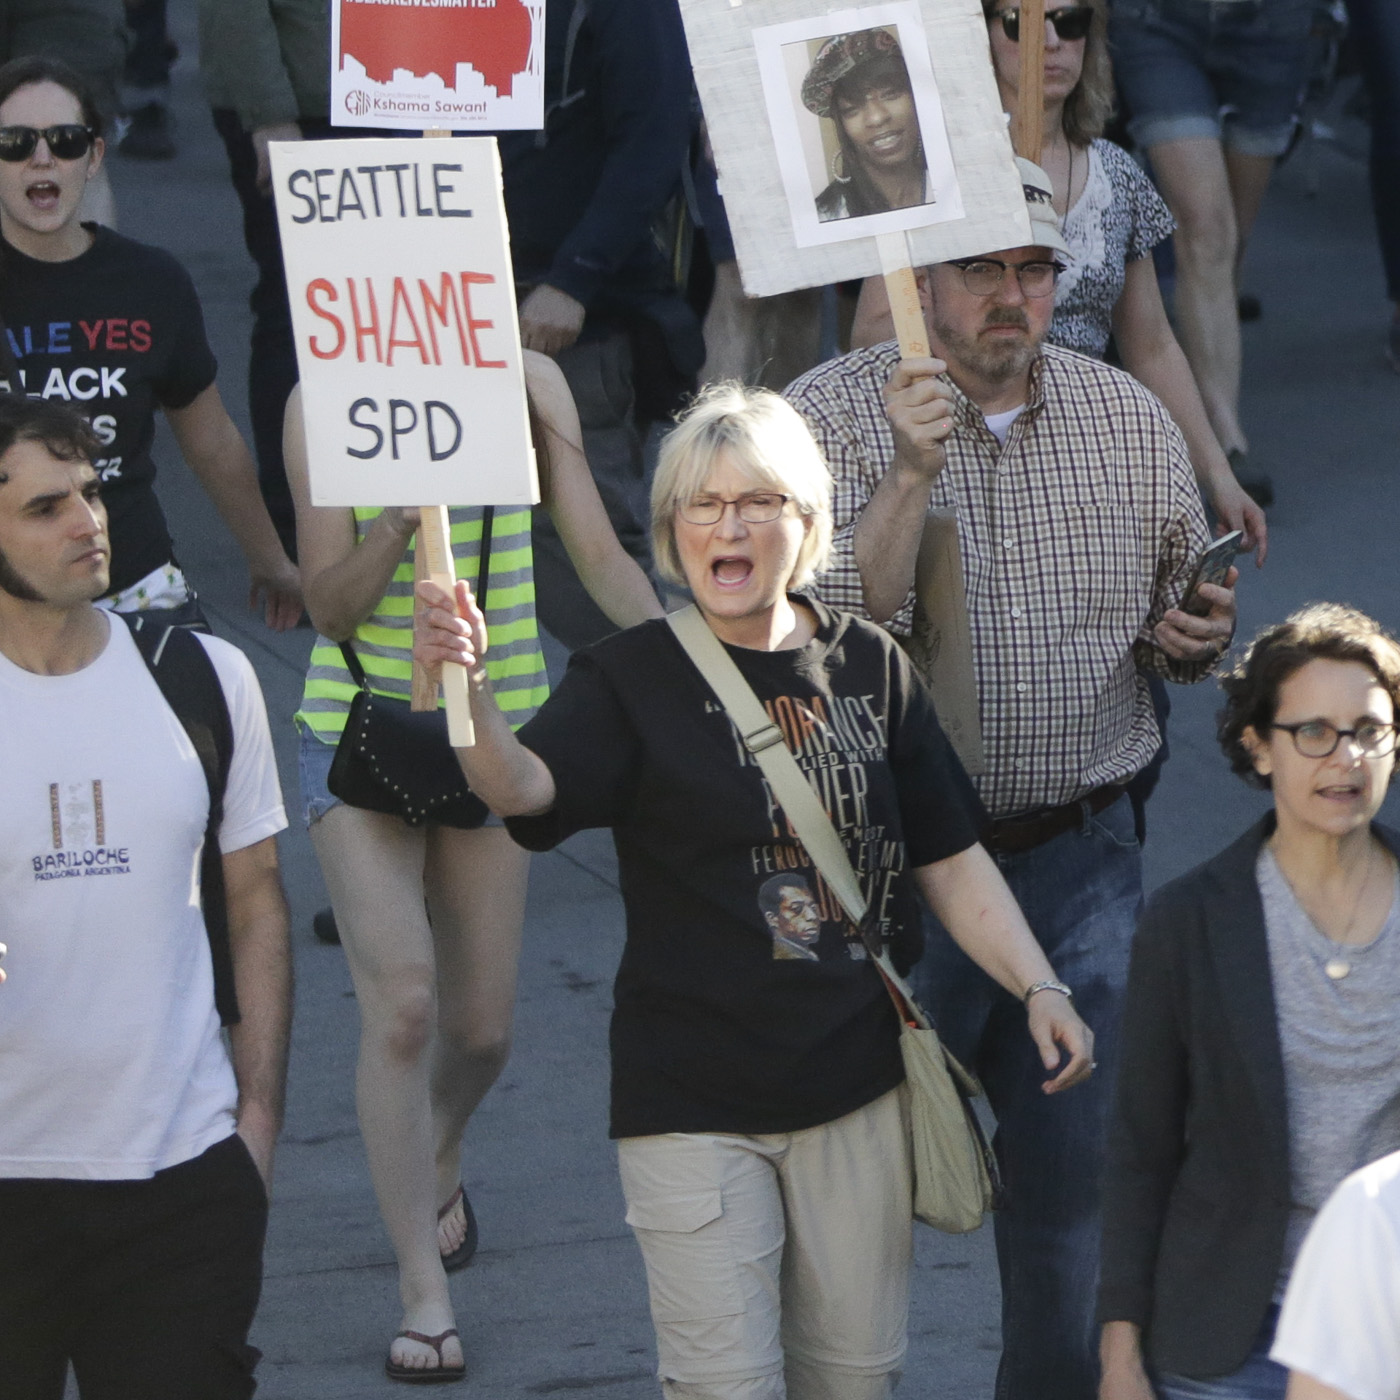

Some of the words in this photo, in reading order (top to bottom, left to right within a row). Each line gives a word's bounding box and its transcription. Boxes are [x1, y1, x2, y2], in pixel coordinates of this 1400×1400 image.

[373, 97, 430, 114] Kshama
[434, 97, 488, 114] Sawant
[287, 162, 473, 224] SEATTLE
[78, 318, 152, 352] YES
[305, 270, 509, 369] SHAME
[345, 396, 464, 462] SPD
[32, 848, 131, 872] BARILOCHE
[84, 865, 132, 878] ARGENTINA
